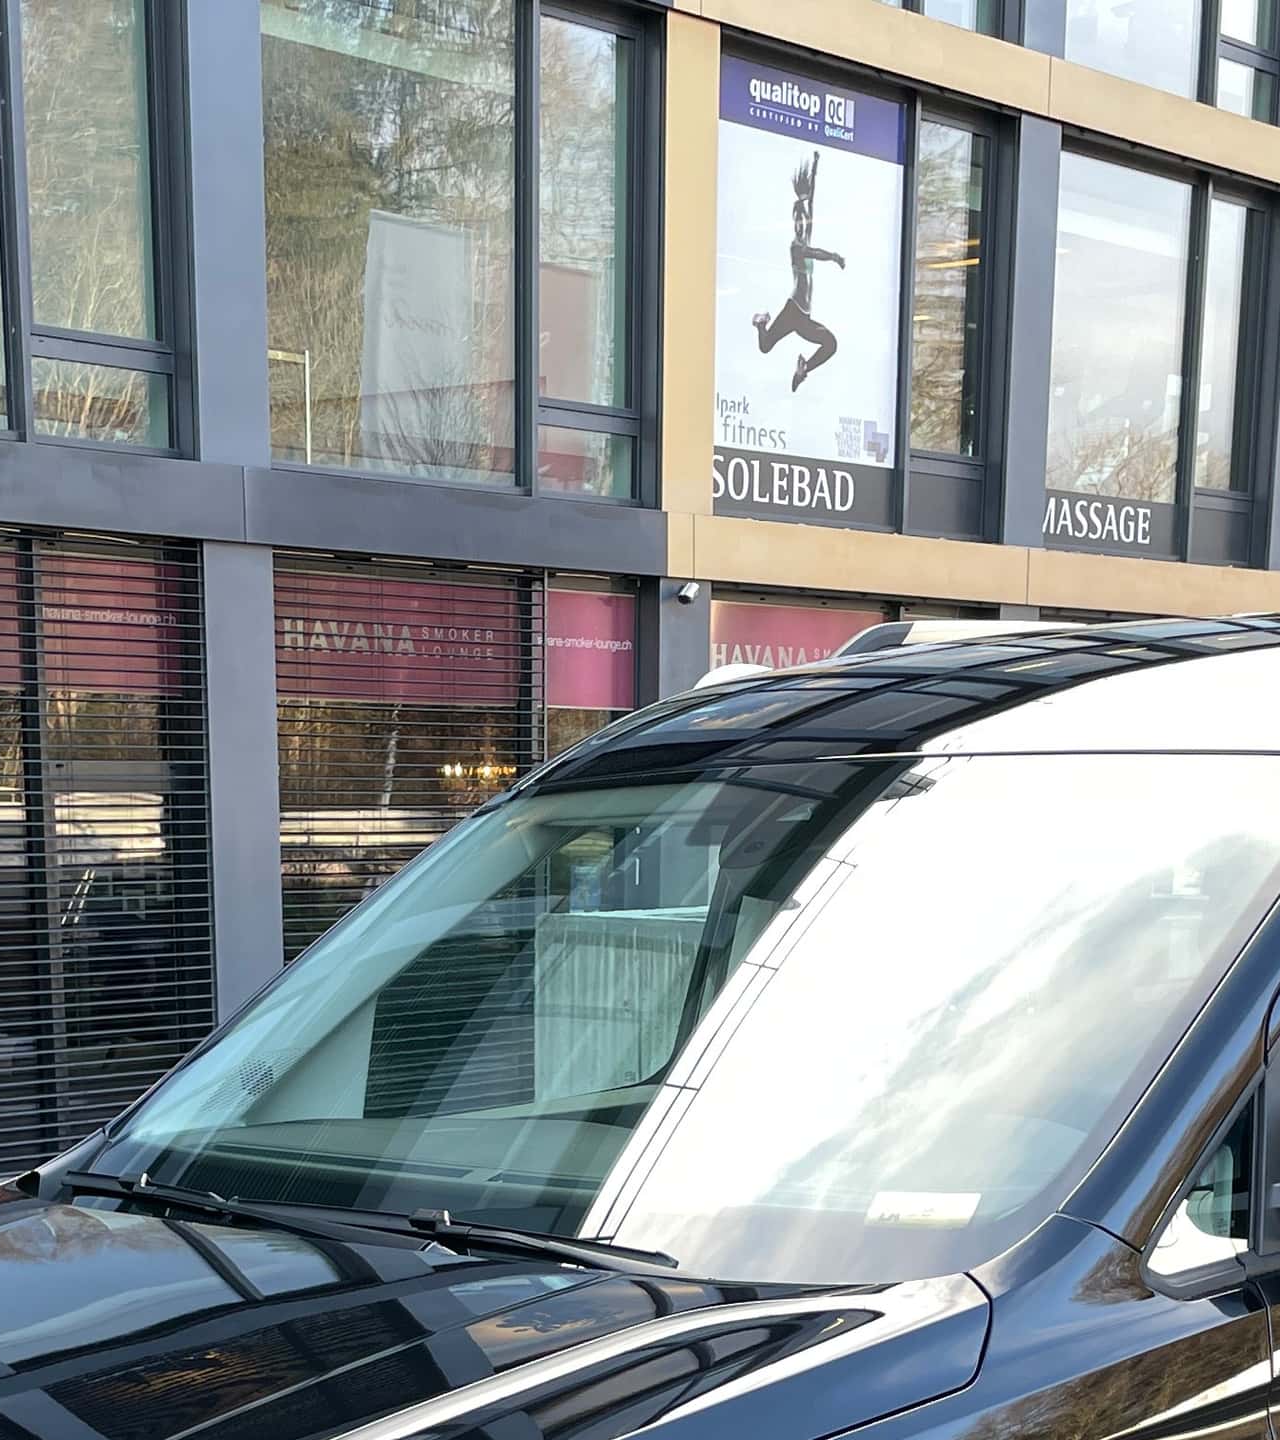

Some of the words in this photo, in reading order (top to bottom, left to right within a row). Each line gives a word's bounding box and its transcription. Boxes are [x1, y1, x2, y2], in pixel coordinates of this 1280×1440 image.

[749, 78, 820, 117] qualitop
[722, 414, 787, 449] fitness
[712, 454, 855, 511] SOLEBAD
[283, 618, 418, 657] HAVANA
[422, 627, 495, 642] SMOKER
